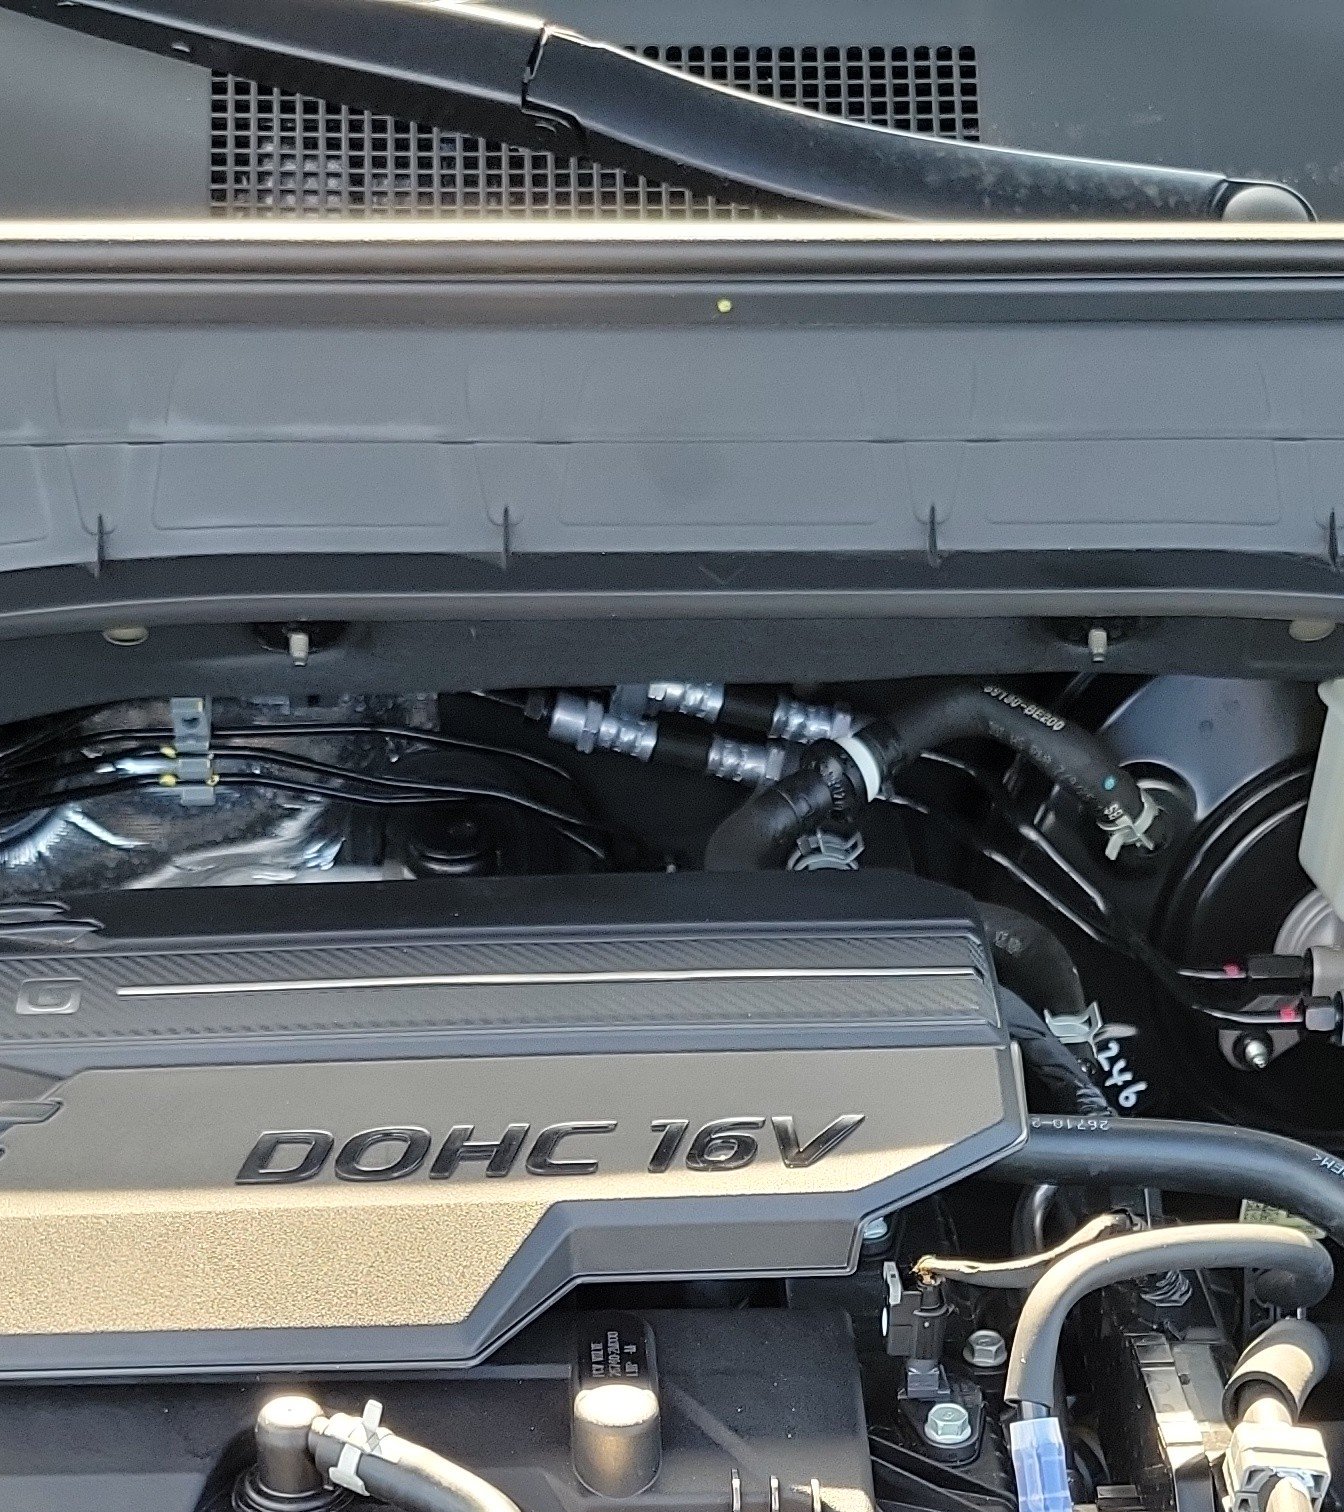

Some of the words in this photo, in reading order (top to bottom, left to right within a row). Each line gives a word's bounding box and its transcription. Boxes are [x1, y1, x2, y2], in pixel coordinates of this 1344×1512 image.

[1096, 1040, 1149, 1108] 246
[234, 1119, 618, 1185] DOHC
[646, 1113, 867, 1172] 16V
